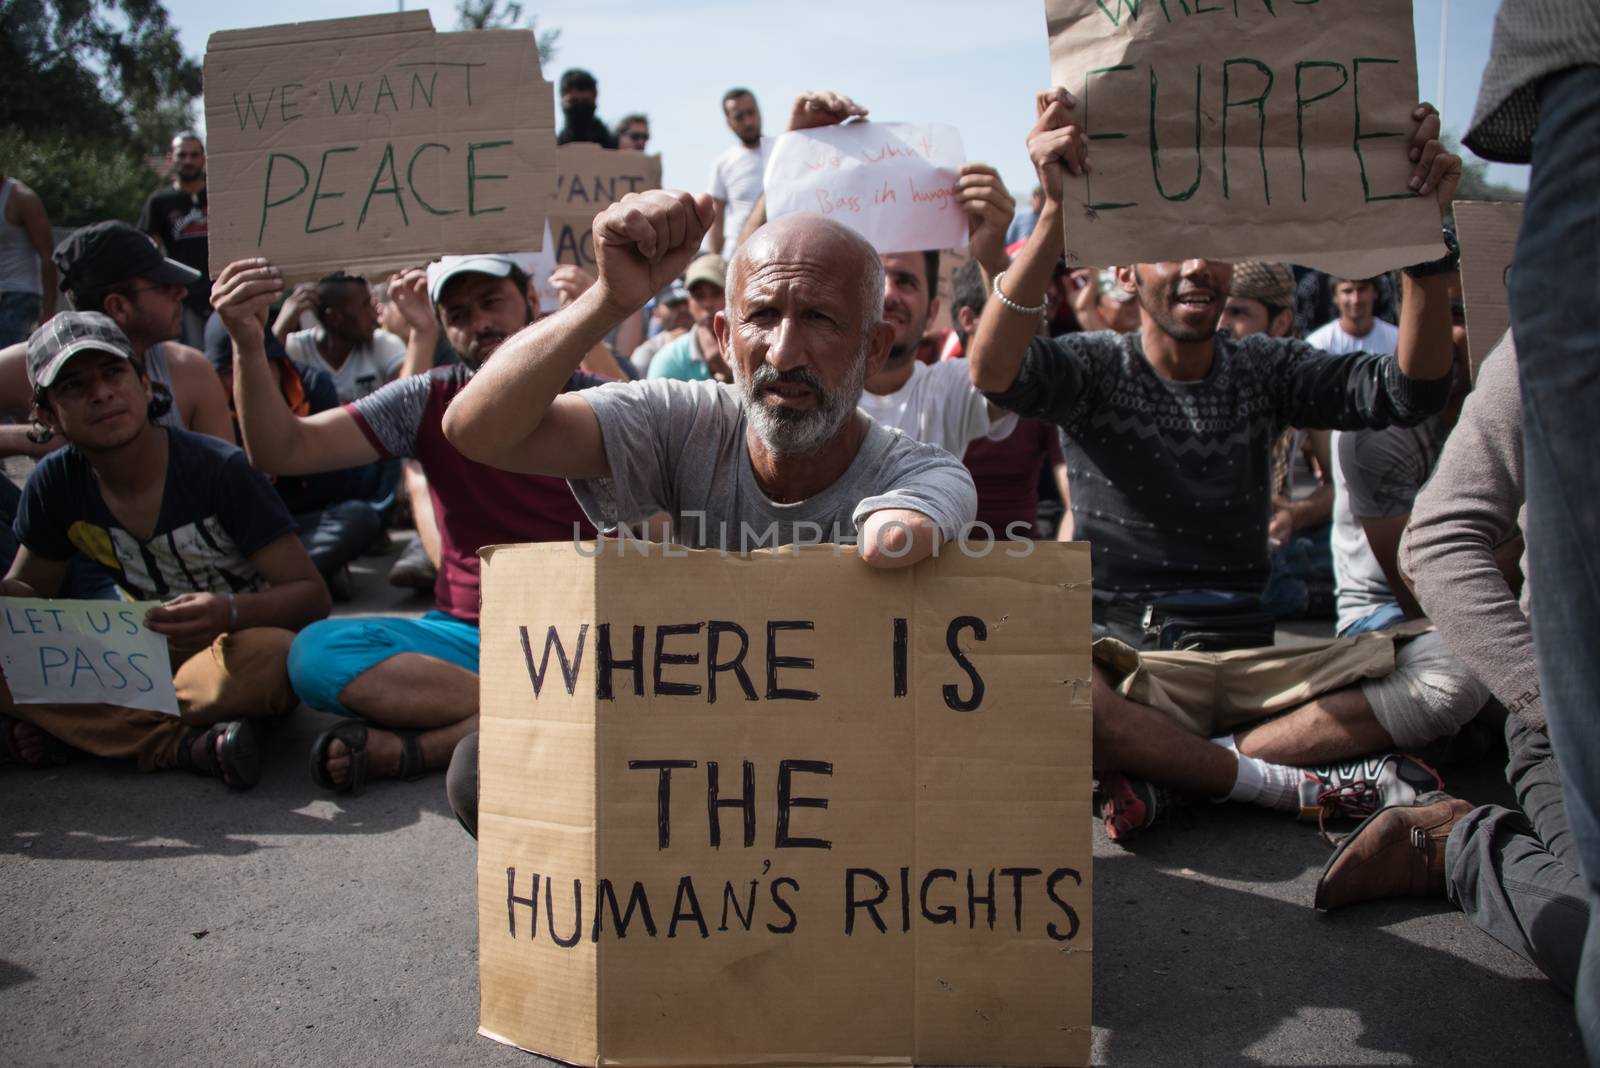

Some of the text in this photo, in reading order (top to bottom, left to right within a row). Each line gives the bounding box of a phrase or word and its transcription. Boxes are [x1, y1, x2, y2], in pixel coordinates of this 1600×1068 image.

[232, 61, 486, 132] WE WANT
[1084, 57, 1420, 210] EURPE
[257, 140, 514, 248] PEACE
[556, 175, 644, 204] ANT
[5, 607, 140, 636] LET US
[518, 615, 988, 712] WHERE IS
[39, 646, 155, 693] PASS
[628, 759, 834, 852] THE
[506, 859, 1083, 948] HUMAN'S RIGHTS
